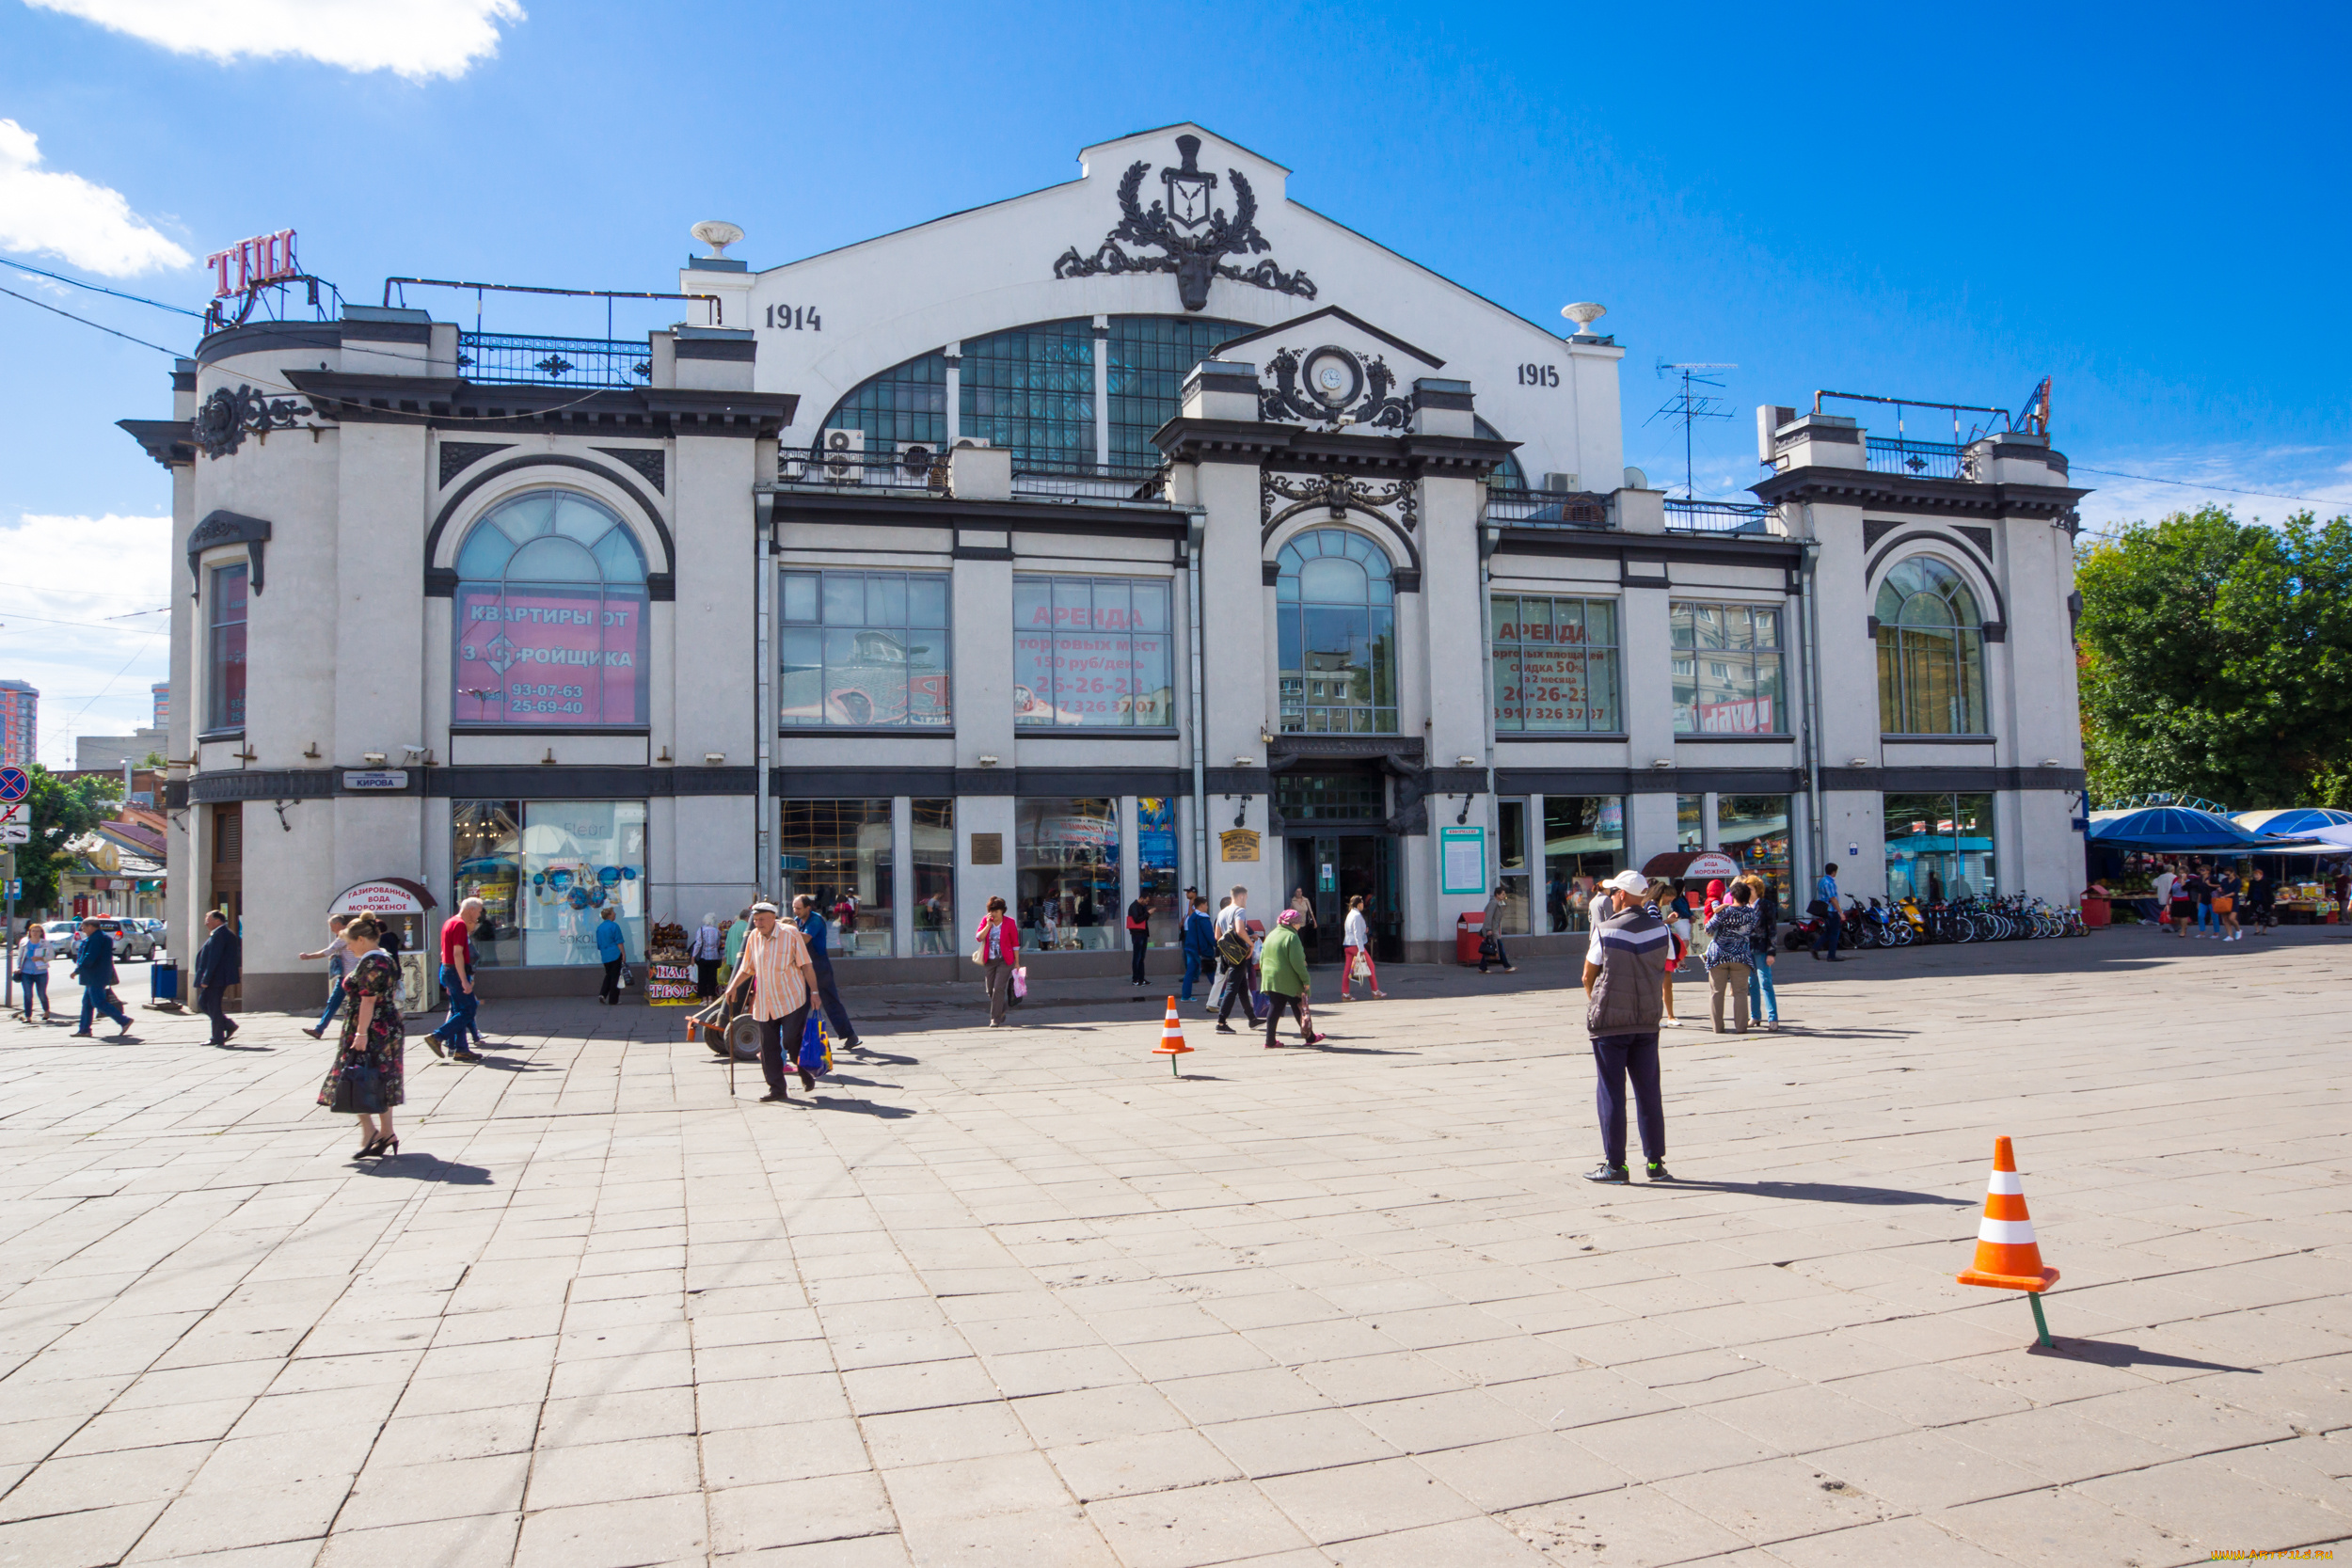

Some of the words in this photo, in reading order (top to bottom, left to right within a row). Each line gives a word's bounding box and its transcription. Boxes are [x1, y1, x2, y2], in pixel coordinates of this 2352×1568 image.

[766, 304, 821, 331] 1914
[1518, 363, 1560, 388] 1915
[470, 605, 593, 626] КВАРТИРЫ
[602, 611, 628, 627] ОТ
[1032, 607, 1144, 629] АРЕНДА
[1499, 623, 1591, 644] АРЕНДА
[1018, 639, 1111, 653] торговых
[1116, 641, 1158, 652] мест
[1492, 650, 1544, 660] оргоых
[1034, 656, 1065, 669] 150
[1069, 657, 1145, 672] руб/день
[1556, 660, 1583, 673] 50%
[1036, 676, 1143, 694] 26-26-23
[1533, 674, 1538, 683] 2
[1541, 676, 1577, 685] месяца
[482, 691, 509, 703] (845)
[511, 683, 583, 698] 93-07-63
[511, 699, 583, 714] 25-69-40
[1074, 701, 1106, 713] 326
[1111, 701, 1132, 713] 37
[1136, 702, 1156, 713] 07
[1535, 707, 1564, 720] 326
[1566, 708, 1583, 720] 37
[348, 886, 411, 900] ГАЗИРОВАННАЯ
[348, 903, 407, 911] МОРОЖЕНОЕ
[559, 935, 597, 944] SOKOL
